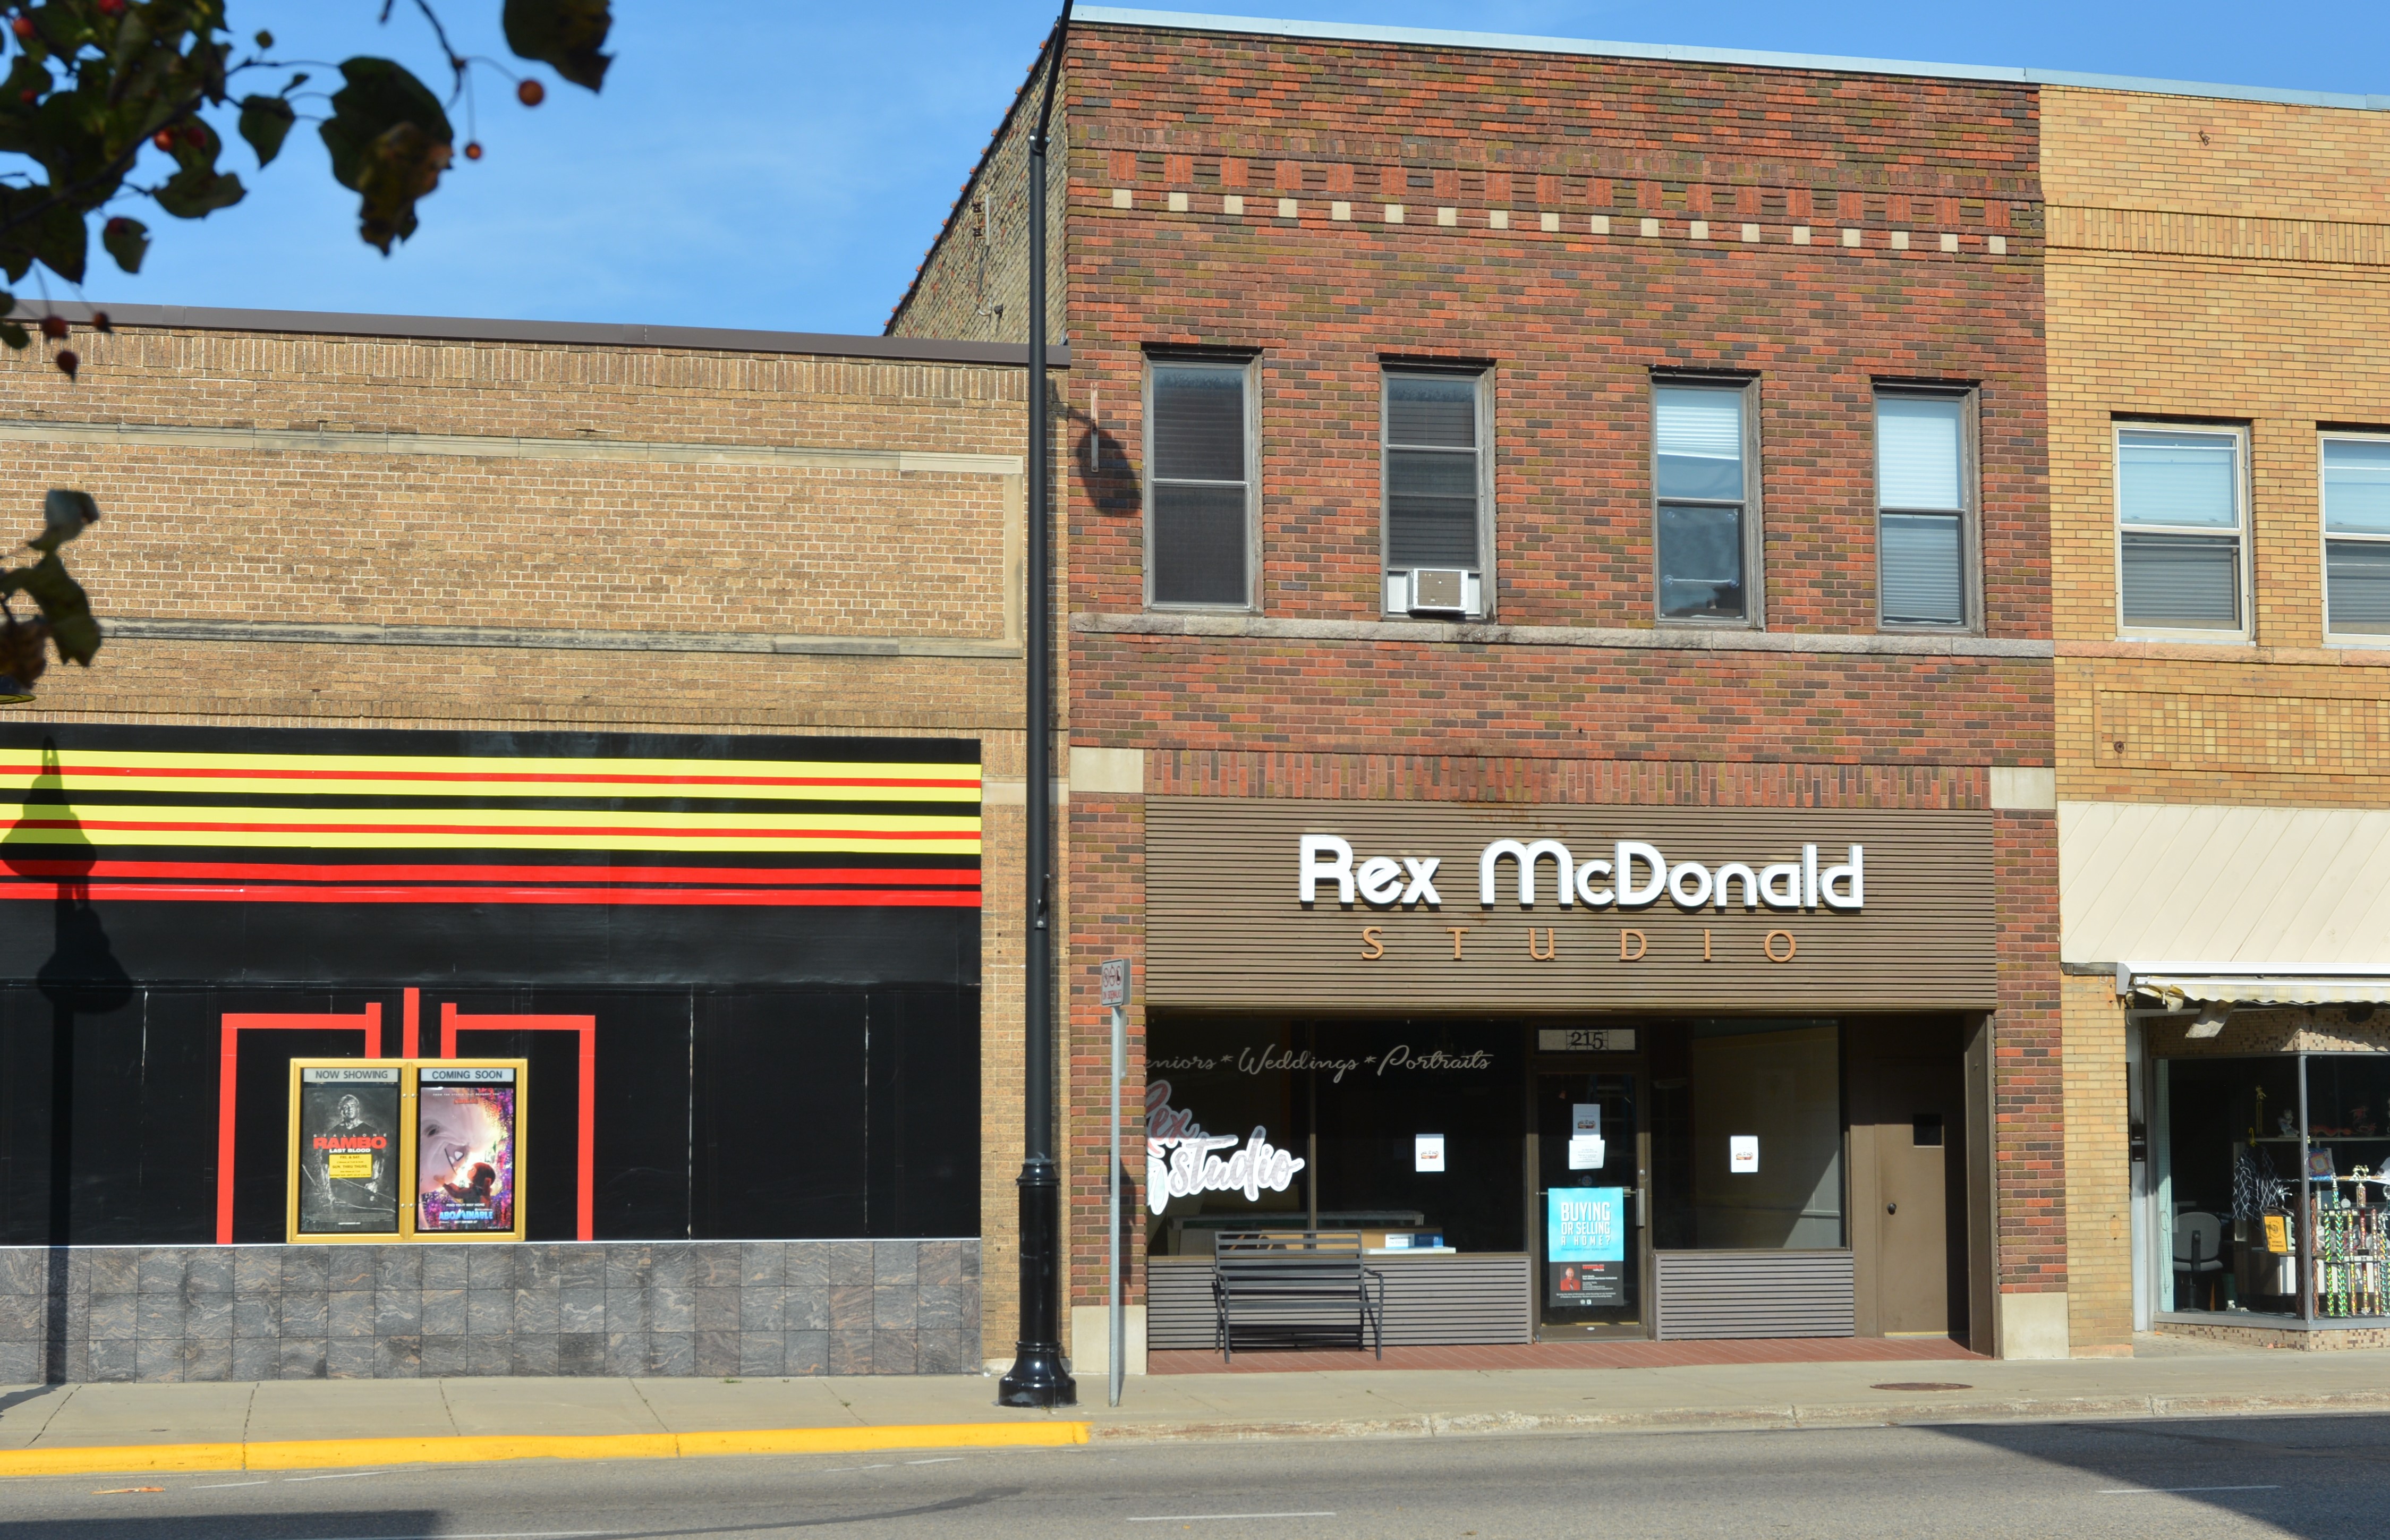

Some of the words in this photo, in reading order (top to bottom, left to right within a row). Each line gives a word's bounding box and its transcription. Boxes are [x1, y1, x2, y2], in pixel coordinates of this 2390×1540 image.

[1299, 835, 1442, 905] Rex
[1479, 839, 1865, 909] McDonald
[1362, 926, 1798, 963] STUDIO
[1571, 1031, 1604, 1050] 215
[1146, 1056, 1217, 1069] eniors
[1238, 1044, 1359, 1083] Weddings
[1377, 1045, 1494, 1076] Portraits
[316, 1070, 339, 1079] NOW
[343, 1070, 388, 1079] SHOWING
[432, 1070, 470, 1079] COMING
[475, 1070, 503, 1079] SOON
[313, 1136, 387, 1149] RAMBO
[439, 1209, 493, 1220] ABOMINABLE
[1561, 1202, 1611, 1221] BUYING
[1561, 1221, 1574, 1235] OR
[1576, 1221, 1611, 1235] SELLING
[1561, 1236, 1567, 1246] A
